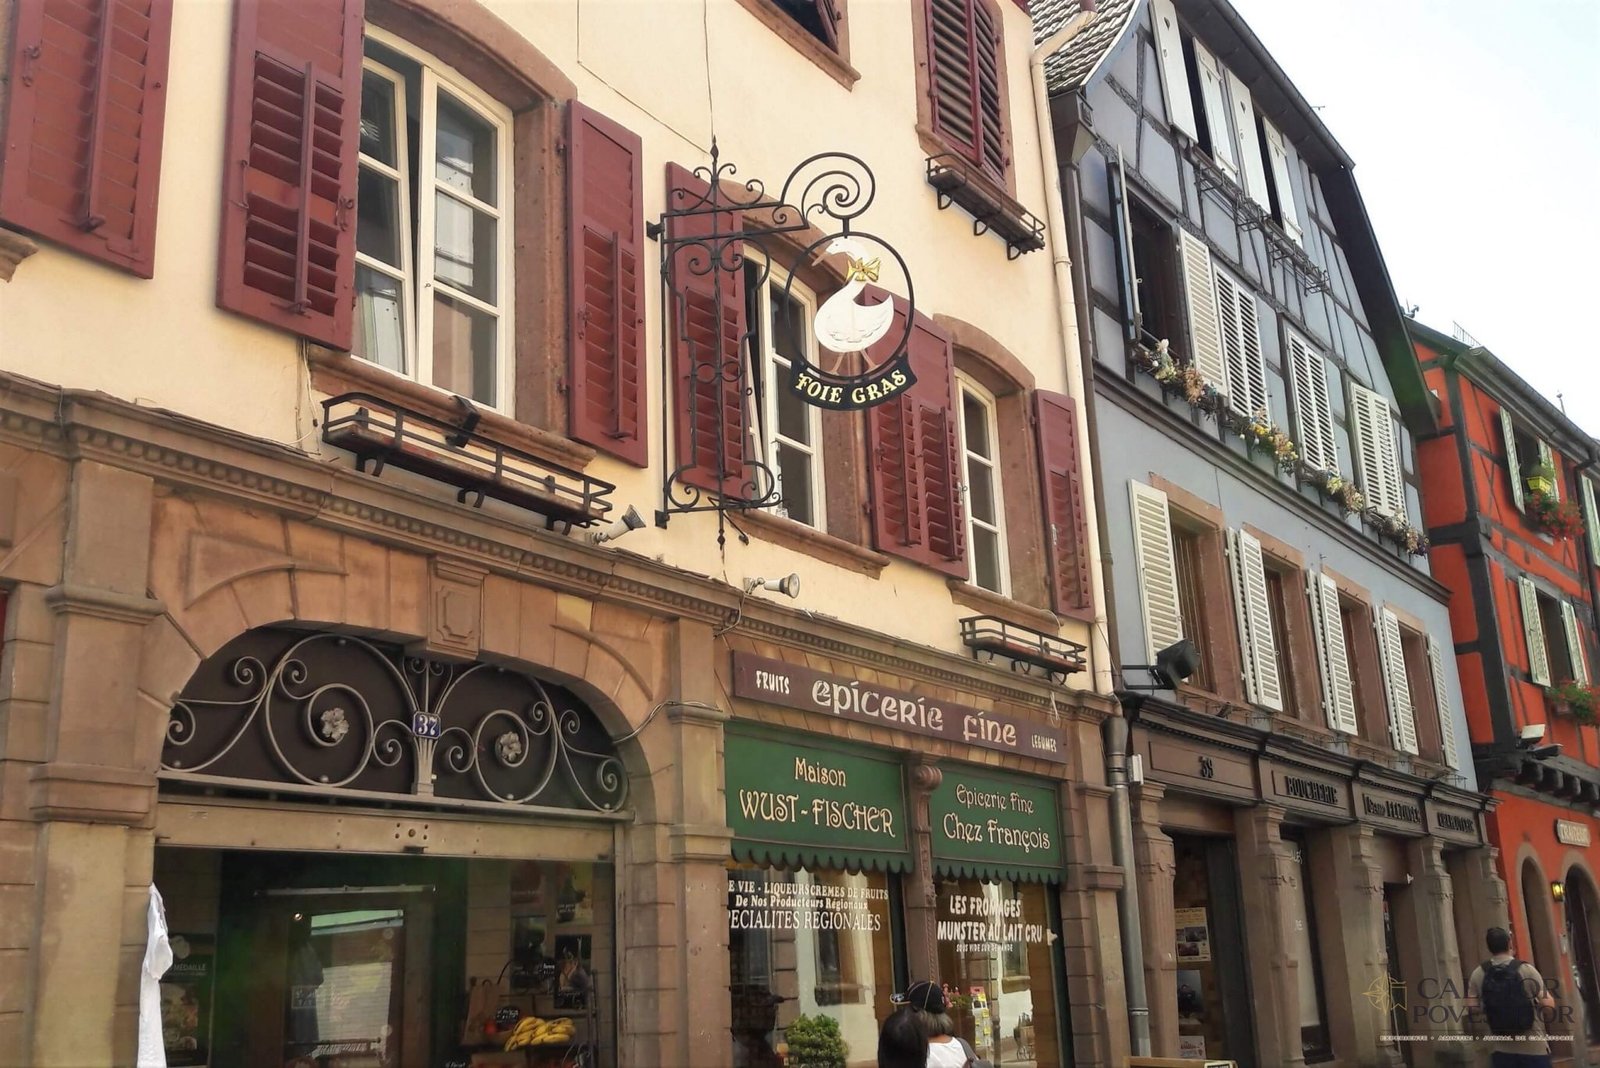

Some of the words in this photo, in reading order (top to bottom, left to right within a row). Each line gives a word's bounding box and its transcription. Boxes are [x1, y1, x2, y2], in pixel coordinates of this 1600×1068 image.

[795, 372, 843, 403] FOIE
[852, 369, 907, 404] GRAS
[756, 670, 790, 694] FRUITS
[1031, 734, 1057, 752] LEGUMES
[418, 715, 437, 735] 37
[795, 757, 847, 787] Maison
[956, 784, 1007, 811] Epicerie
[1010, 792, 1034, 815] Fine
[943, 812, 982, 843] Chez
[987, 819, 1051, 853] François
[738, 880, 755, 893] VIE
[847, 887, 858, 898] DE
[860, 887, 889, 900] FRUITS
[736, 895, 748, 907] De
[751, 895, 767, 907] Nos
[770, 895, 824, 909] Producteurs
[950, 895, 967, 915] LES
[970, 896, 1022, 917] FROMAGES
[804, 911, 881, 931] REGIONALES
[937, 921, 986, 941] MUNSTER
[988, 922, 1001, 941] AU
[1003, 923, 1023, 941] LAIT
[1025, 924, 1043, 943] CRU
